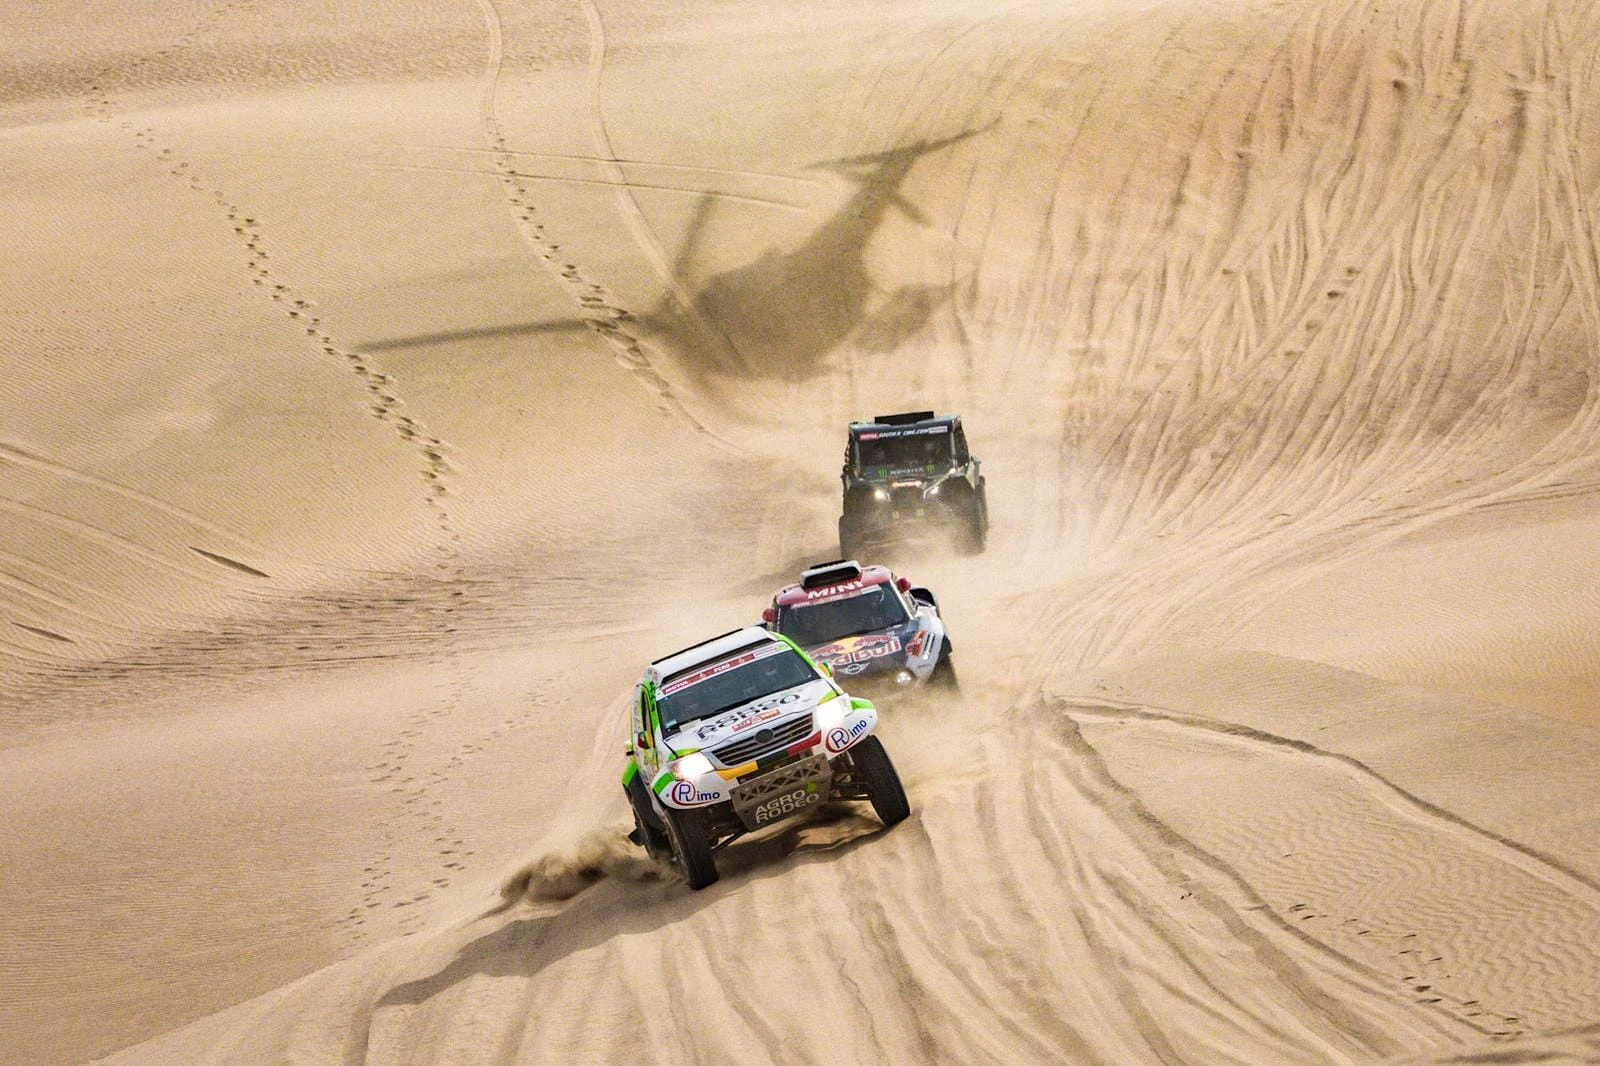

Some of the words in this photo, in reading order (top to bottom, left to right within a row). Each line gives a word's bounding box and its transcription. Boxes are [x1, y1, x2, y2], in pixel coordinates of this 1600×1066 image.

[807, 581, 864, 600] MINI
[852, 636, 902, 663] Bull
[755, 789, 806, 816] AGRO
[755, 793, 820, 824] RODEO
